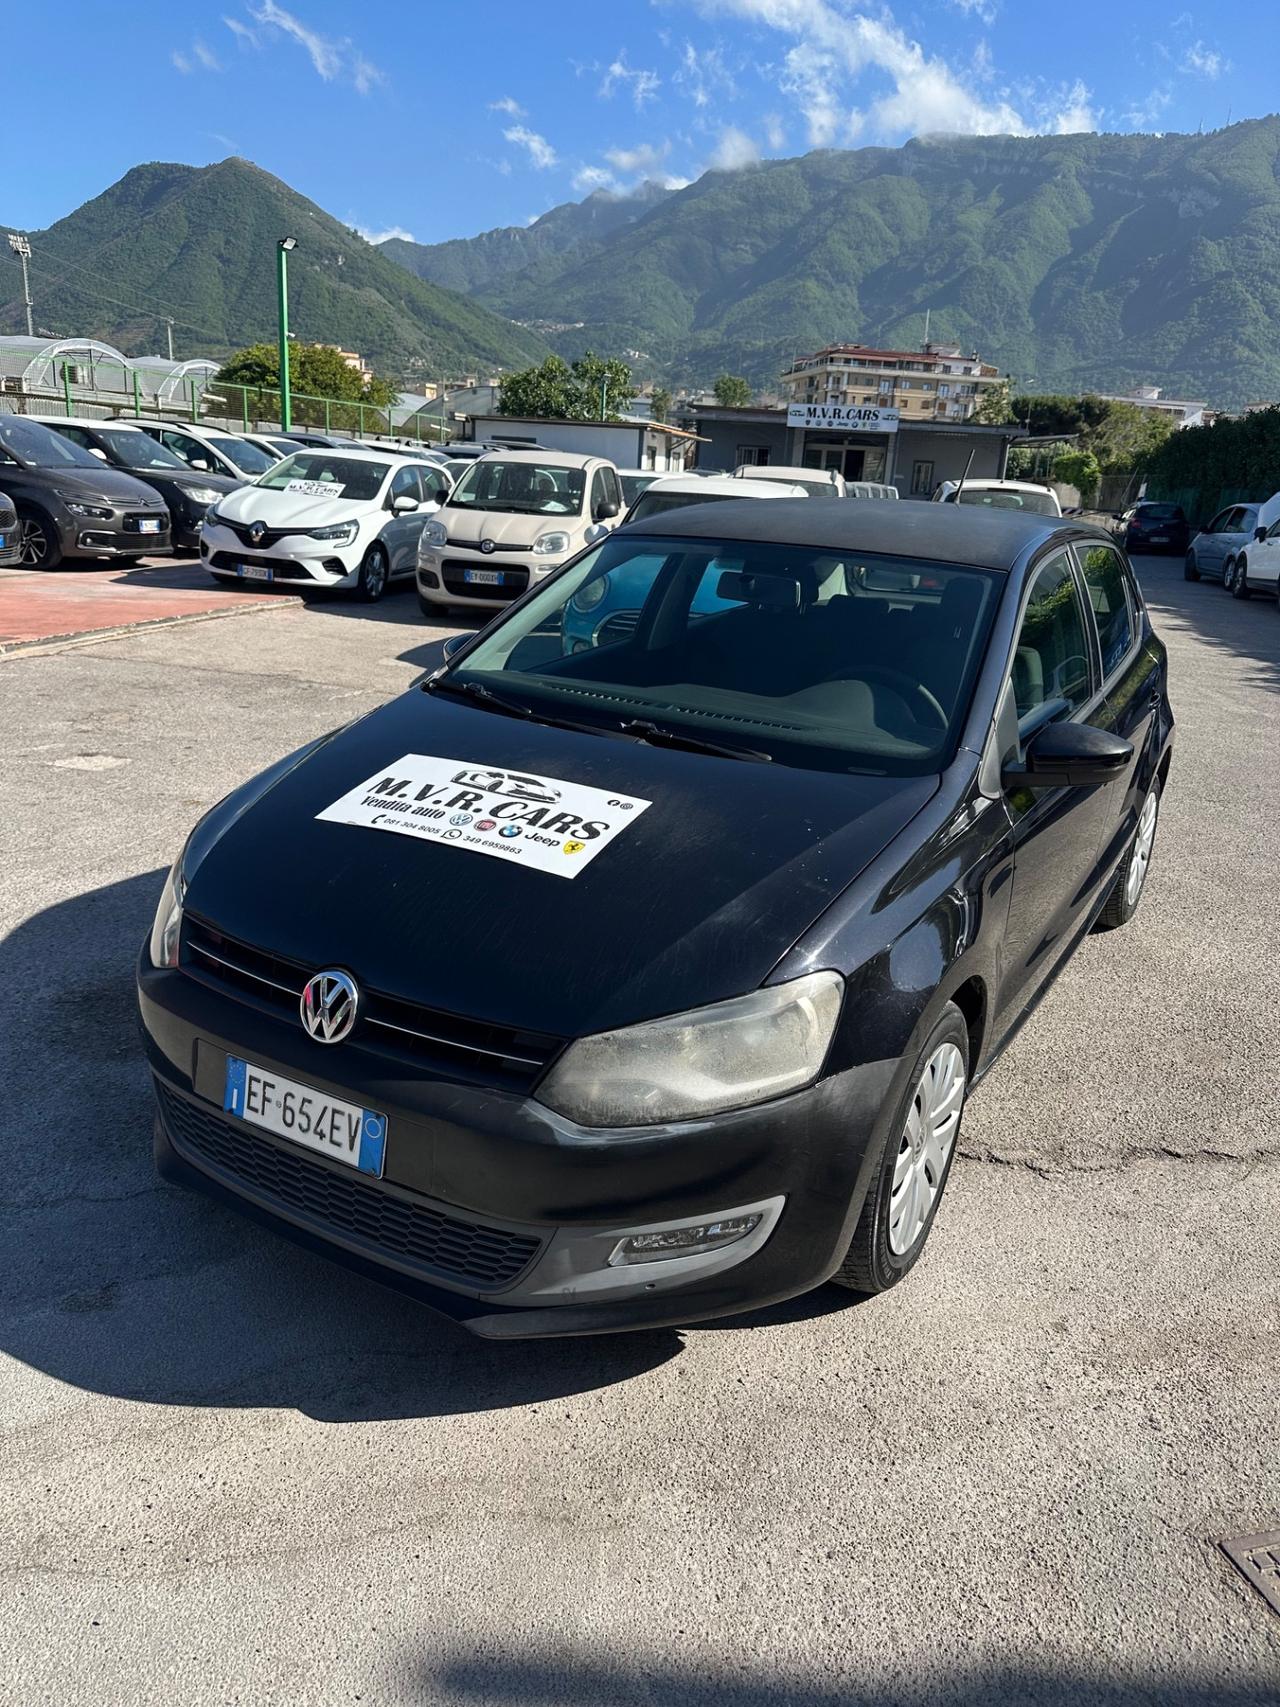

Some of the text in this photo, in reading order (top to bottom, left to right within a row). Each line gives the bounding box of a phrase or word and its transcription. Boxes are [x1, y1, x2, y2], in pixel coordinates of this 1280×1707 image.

[807, 406, 880, 421] M.V.R.CARS
[360, 796, 446, 819] Vendita auto
[366, 777, 610, 840] M.V.R.CARS
[383, 818, 400, 826] 081
[400, 821, 418, 829] 304
[463, 835, 522, 854] 349 6959863
[524, 832, 560, 847] Jeep
